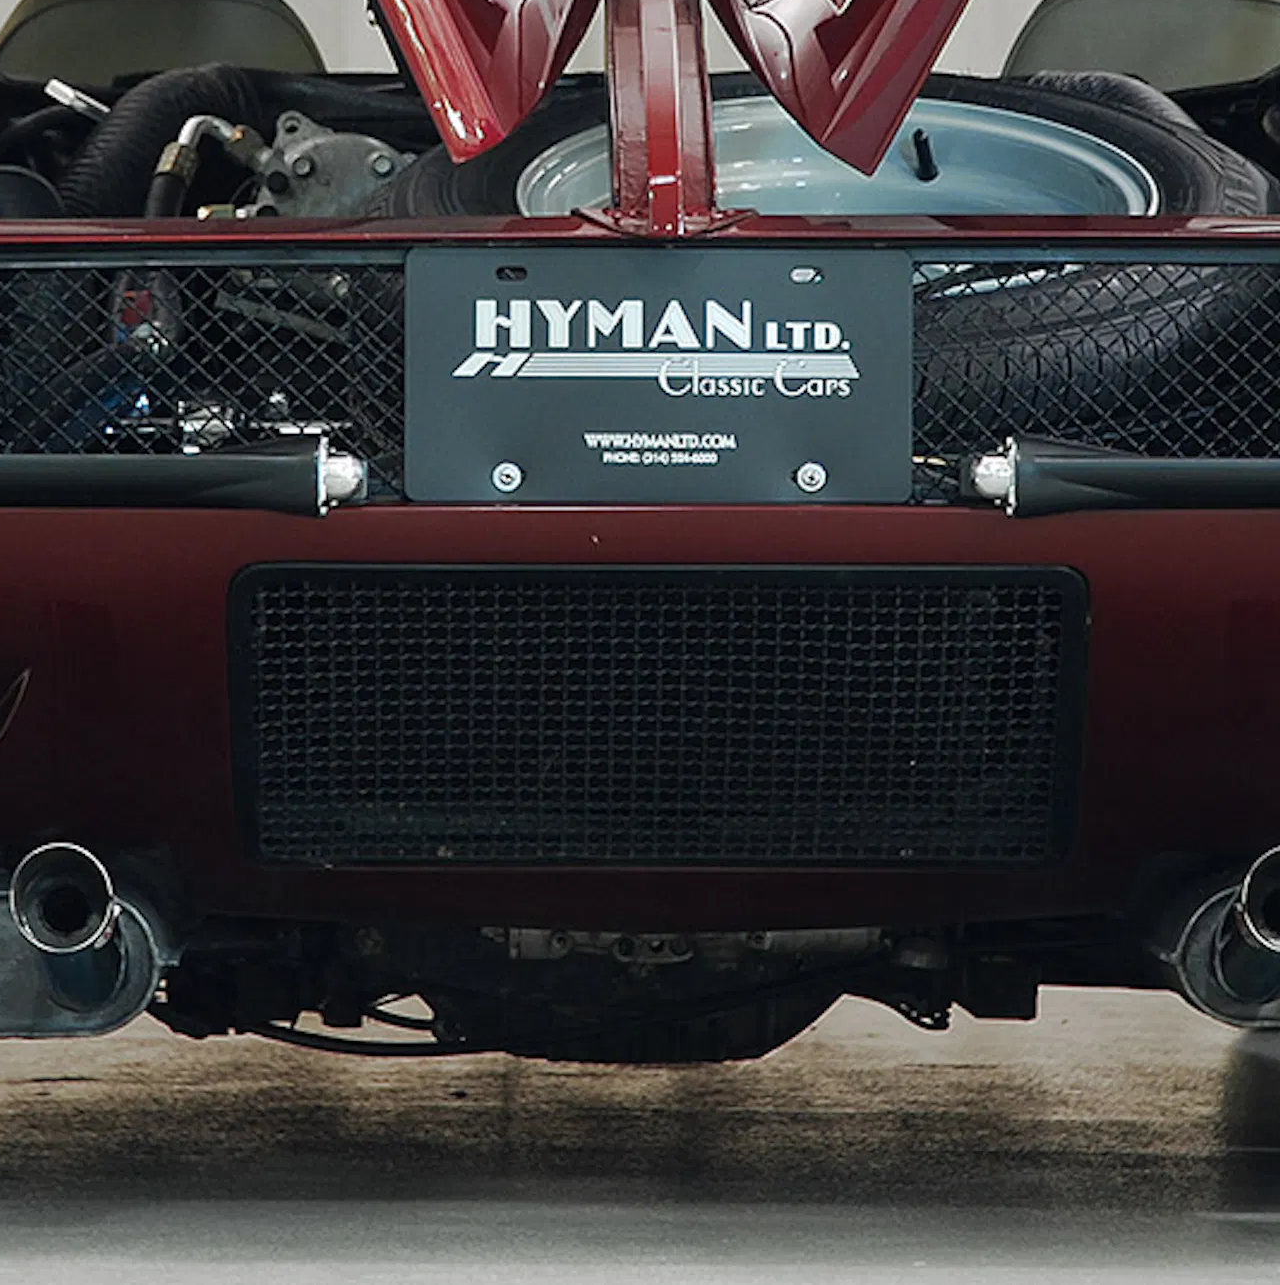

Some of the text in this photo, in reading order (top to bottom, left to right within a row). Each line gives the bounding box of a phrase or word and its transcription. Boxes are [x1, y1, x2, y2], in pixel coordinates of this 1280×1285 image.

[475, 299, 851, 350] HYMAN LTD.
[657, 357, 852, 397] Classic Cars
